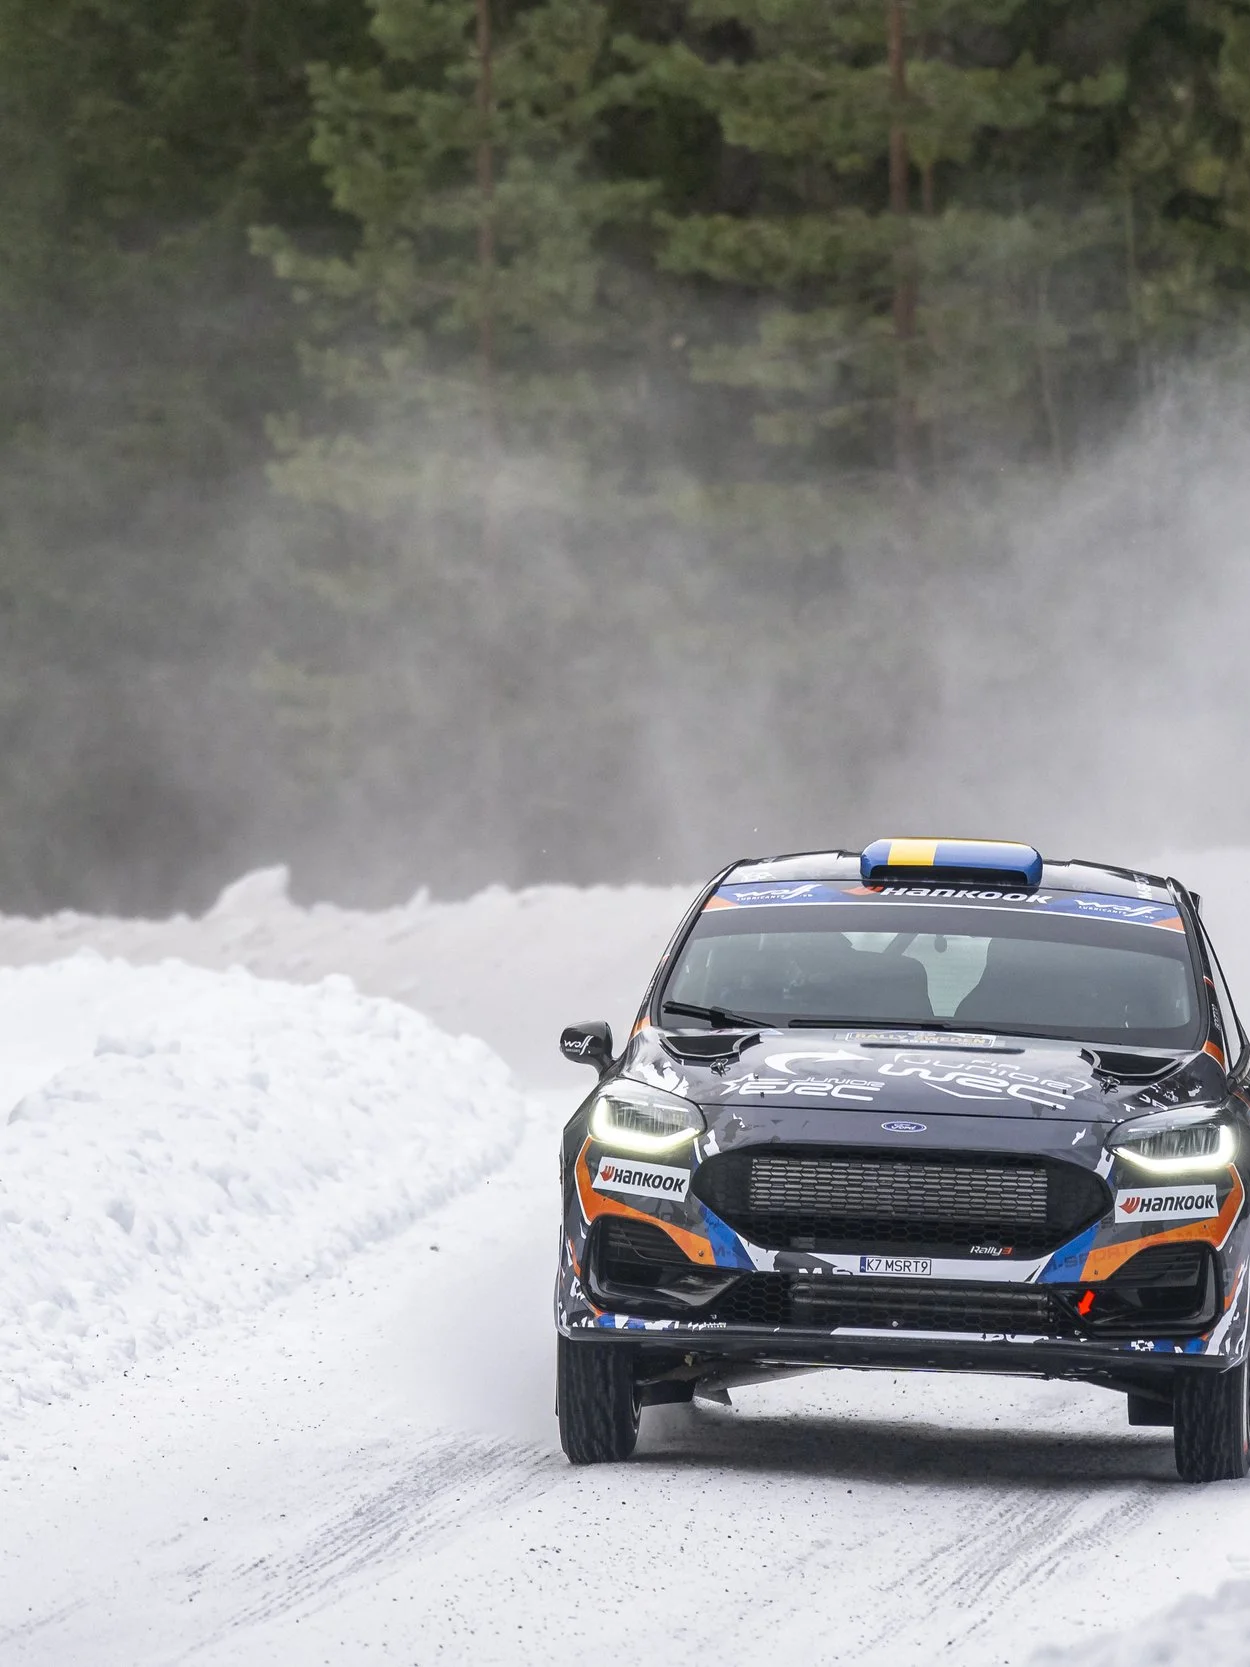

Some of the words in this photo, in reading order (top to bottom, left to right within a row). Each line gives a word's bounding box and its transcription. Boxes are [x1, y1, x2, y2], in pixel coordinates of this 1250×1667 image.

[791, 1076, 886, 1088] JUNIOR
[877, 1063, 1076, 1110] WRC
[970, 1245, 1012, 1257] Rally3
[866, 1258, 881, 1271] K7
[885, 1260, 928, 1273] MSRT9
